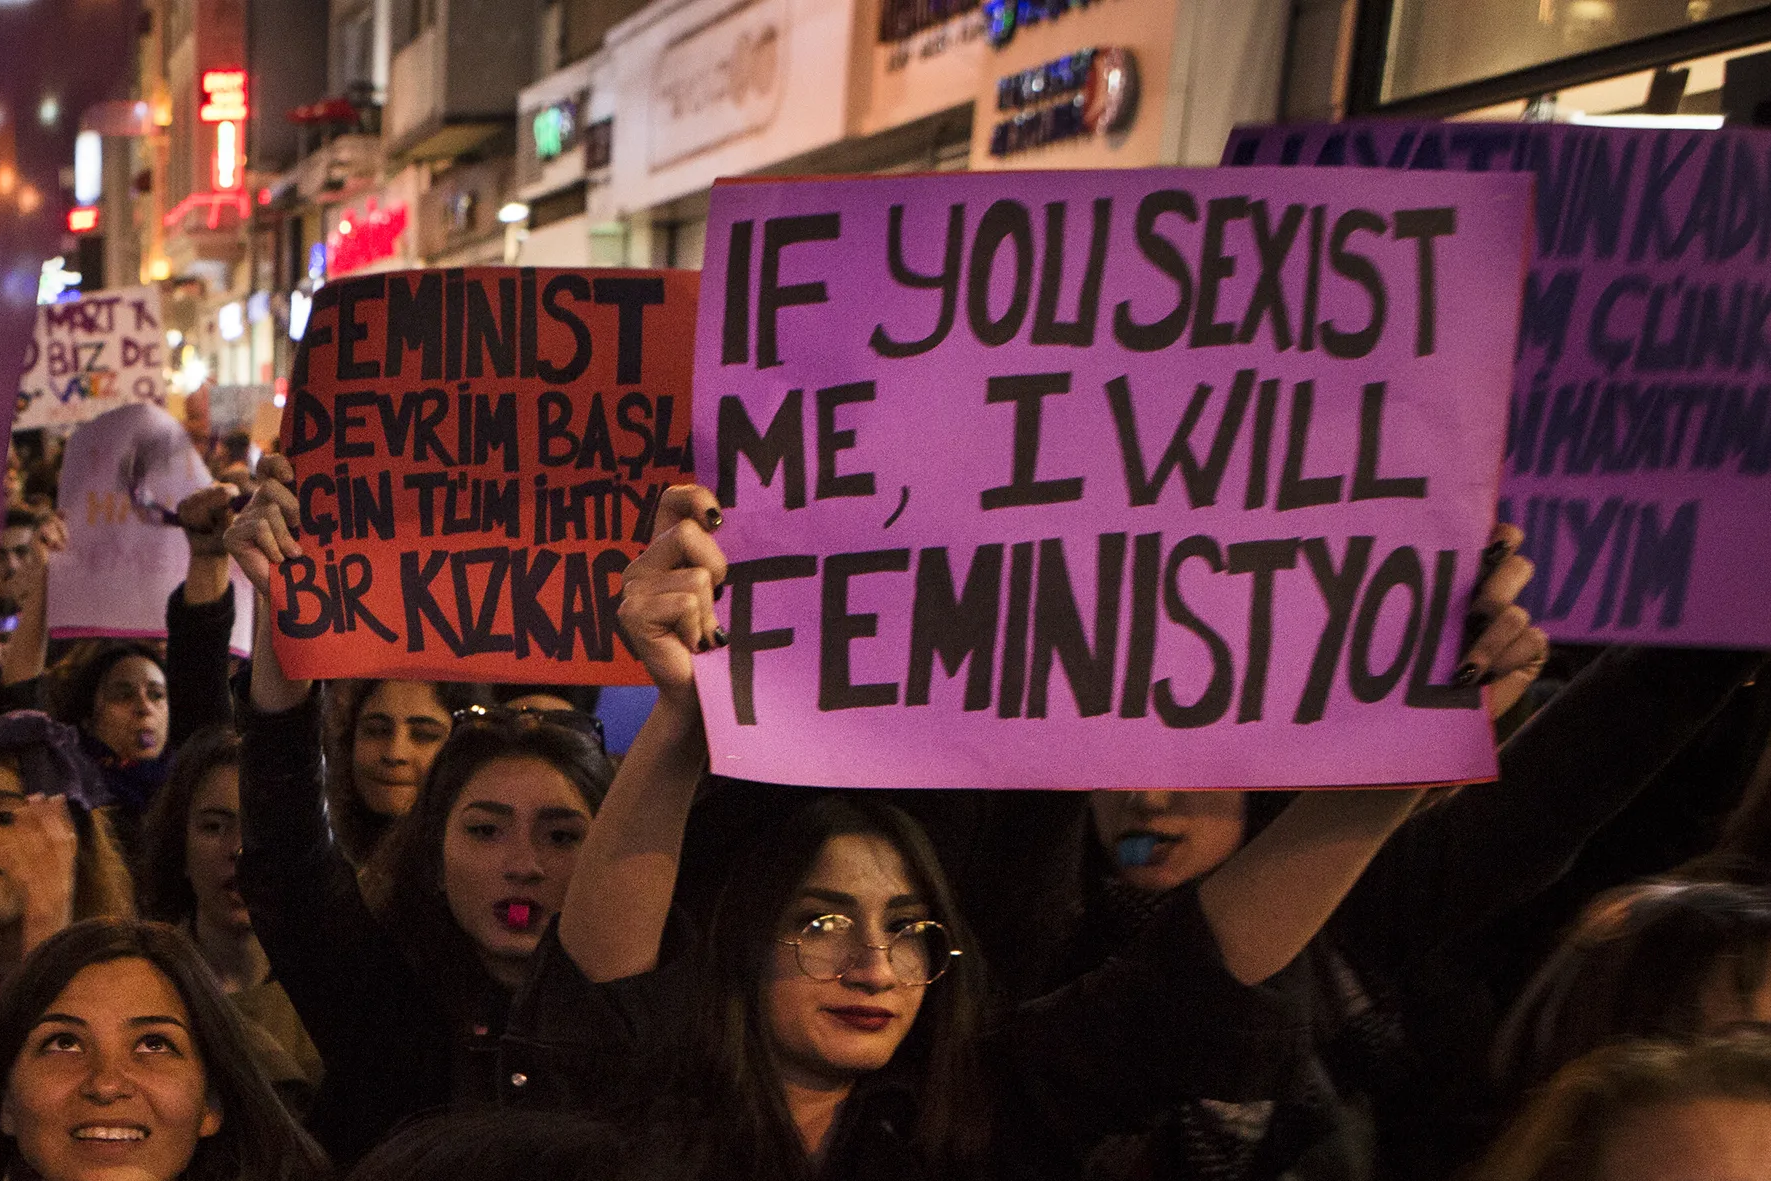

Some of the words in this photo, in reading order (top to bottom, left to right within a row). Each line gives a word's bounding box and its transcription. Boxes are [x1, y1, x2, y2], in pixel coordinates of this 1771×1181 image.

[720, 211, 841, 370] IF
[868, 197, 1114, 358] YOU
[1114, 188, 1458, 360] SEXIST
[288, 383, 519, 472] DEVRİM
[537, 391, 694, 481] BAŞL
[981, 371, 1085, 511] I
[1104, 367, 1429, 513] WILL
[288, 463, 396, 547] ÇİN
[403, 471, 520, 538] TÜM
[534, 474, 663, 546] İHTİY
[277, 549, 399, 643] BİR
[725, 530, 1305, 729] FEMINIST
